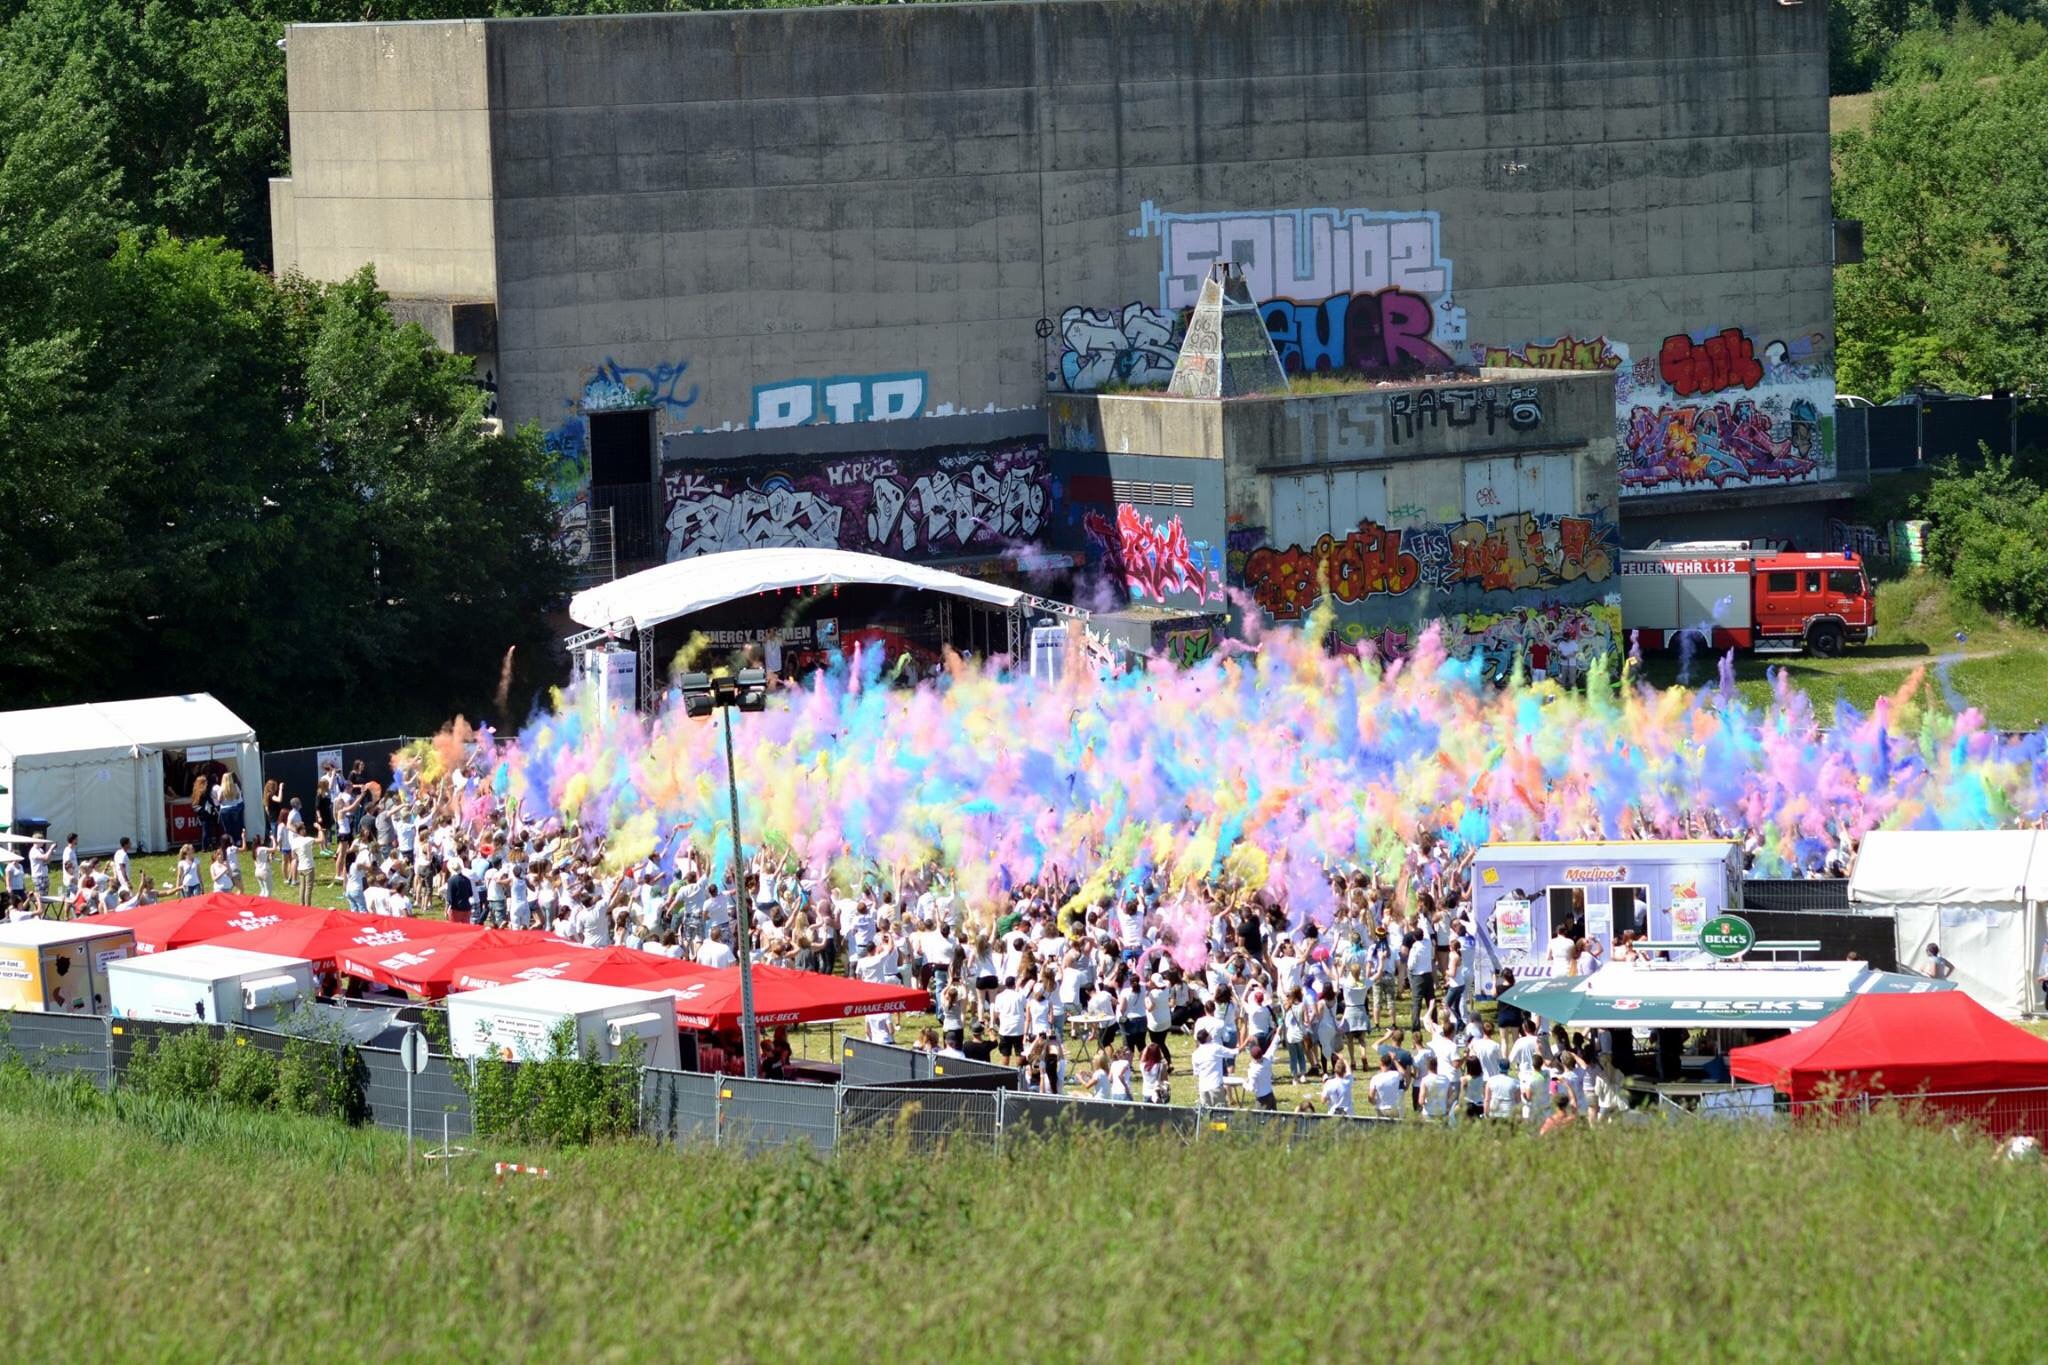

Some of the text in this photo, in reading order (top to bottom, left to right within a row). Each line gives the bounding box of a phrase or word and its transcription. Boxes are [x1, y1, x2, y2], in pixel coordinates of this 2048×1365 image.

[1621, 561, 1736, 575] FEUERWEHR 112
[1566, 867, 1614, 879] Merlino
[1705, 934, 1747, 944] BECK'S
[854, 1001, 906, 1014] HAAKE-BECK
[1670, 1000, 1825, 1011] BECK'S
